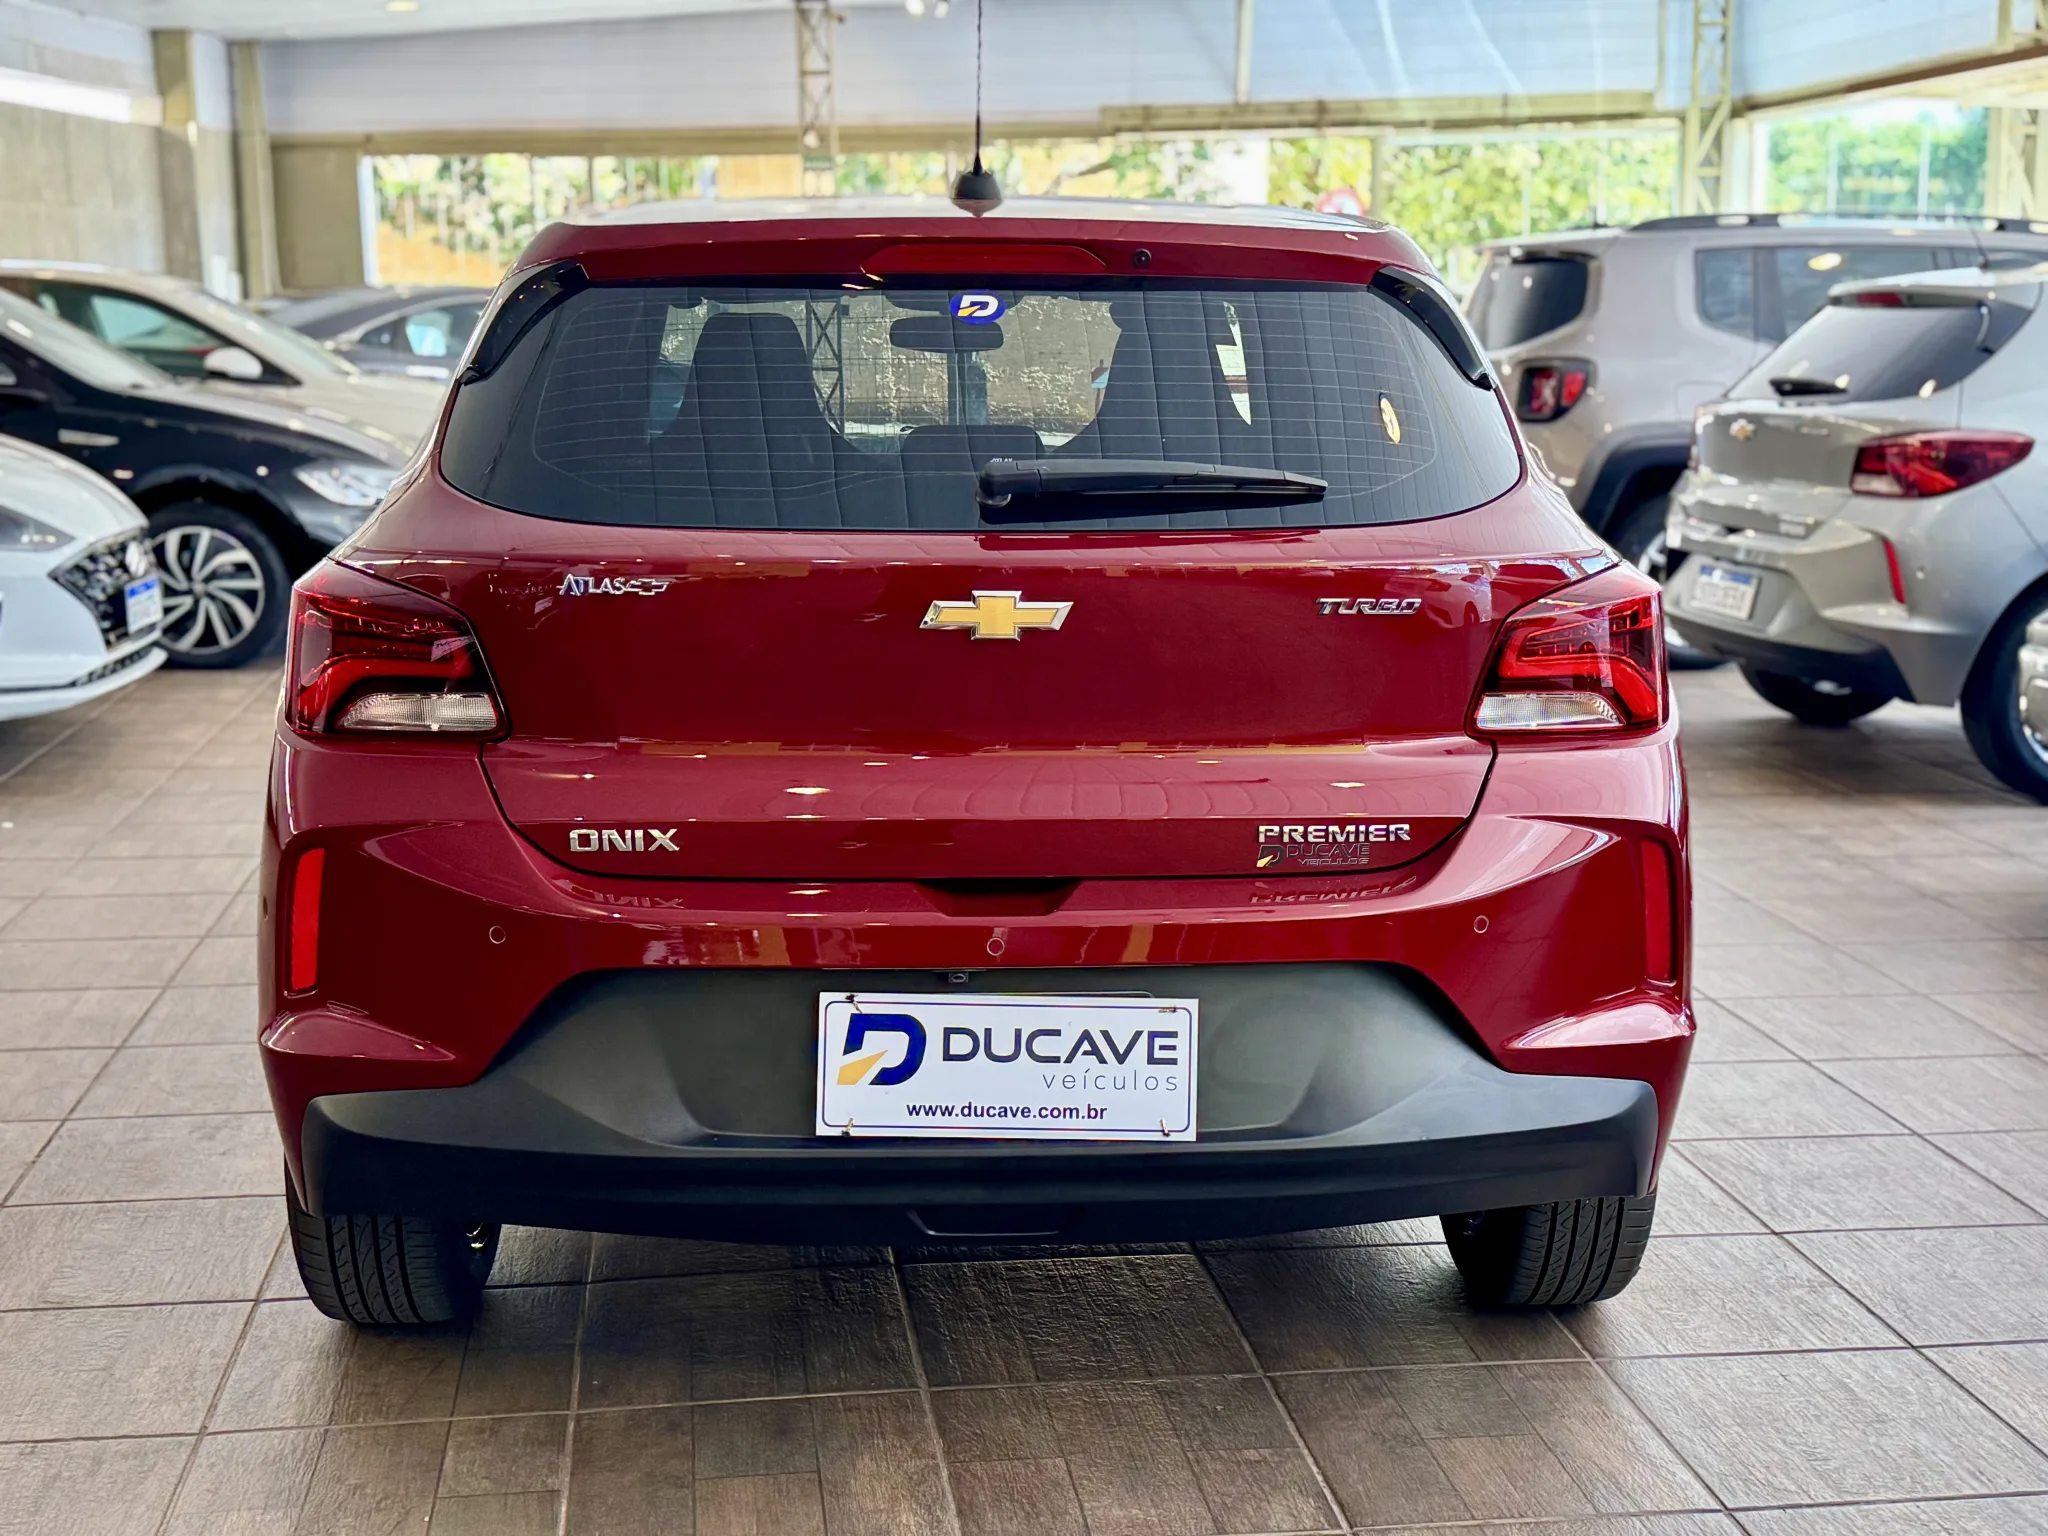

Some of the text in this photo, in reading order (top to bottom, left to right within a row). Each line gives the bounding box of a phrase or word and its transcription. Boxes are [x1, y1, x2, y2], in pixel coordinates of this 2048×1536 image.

[556, 573, 627, 596] ATLAS
[1316, 598, 1422, 615] TURBO
[569, 828, 681, 852] ONIX
[1258, 823, 1411, 843] PREMIER
[1286, 842, 1371, 858] DUCAVE
[942, 1026, 1179, 1066] DUCAVE
[1042, 1067, 1178, 1092] veículos
[905, 1101, 1108, 1121] www.ducave.com.br
